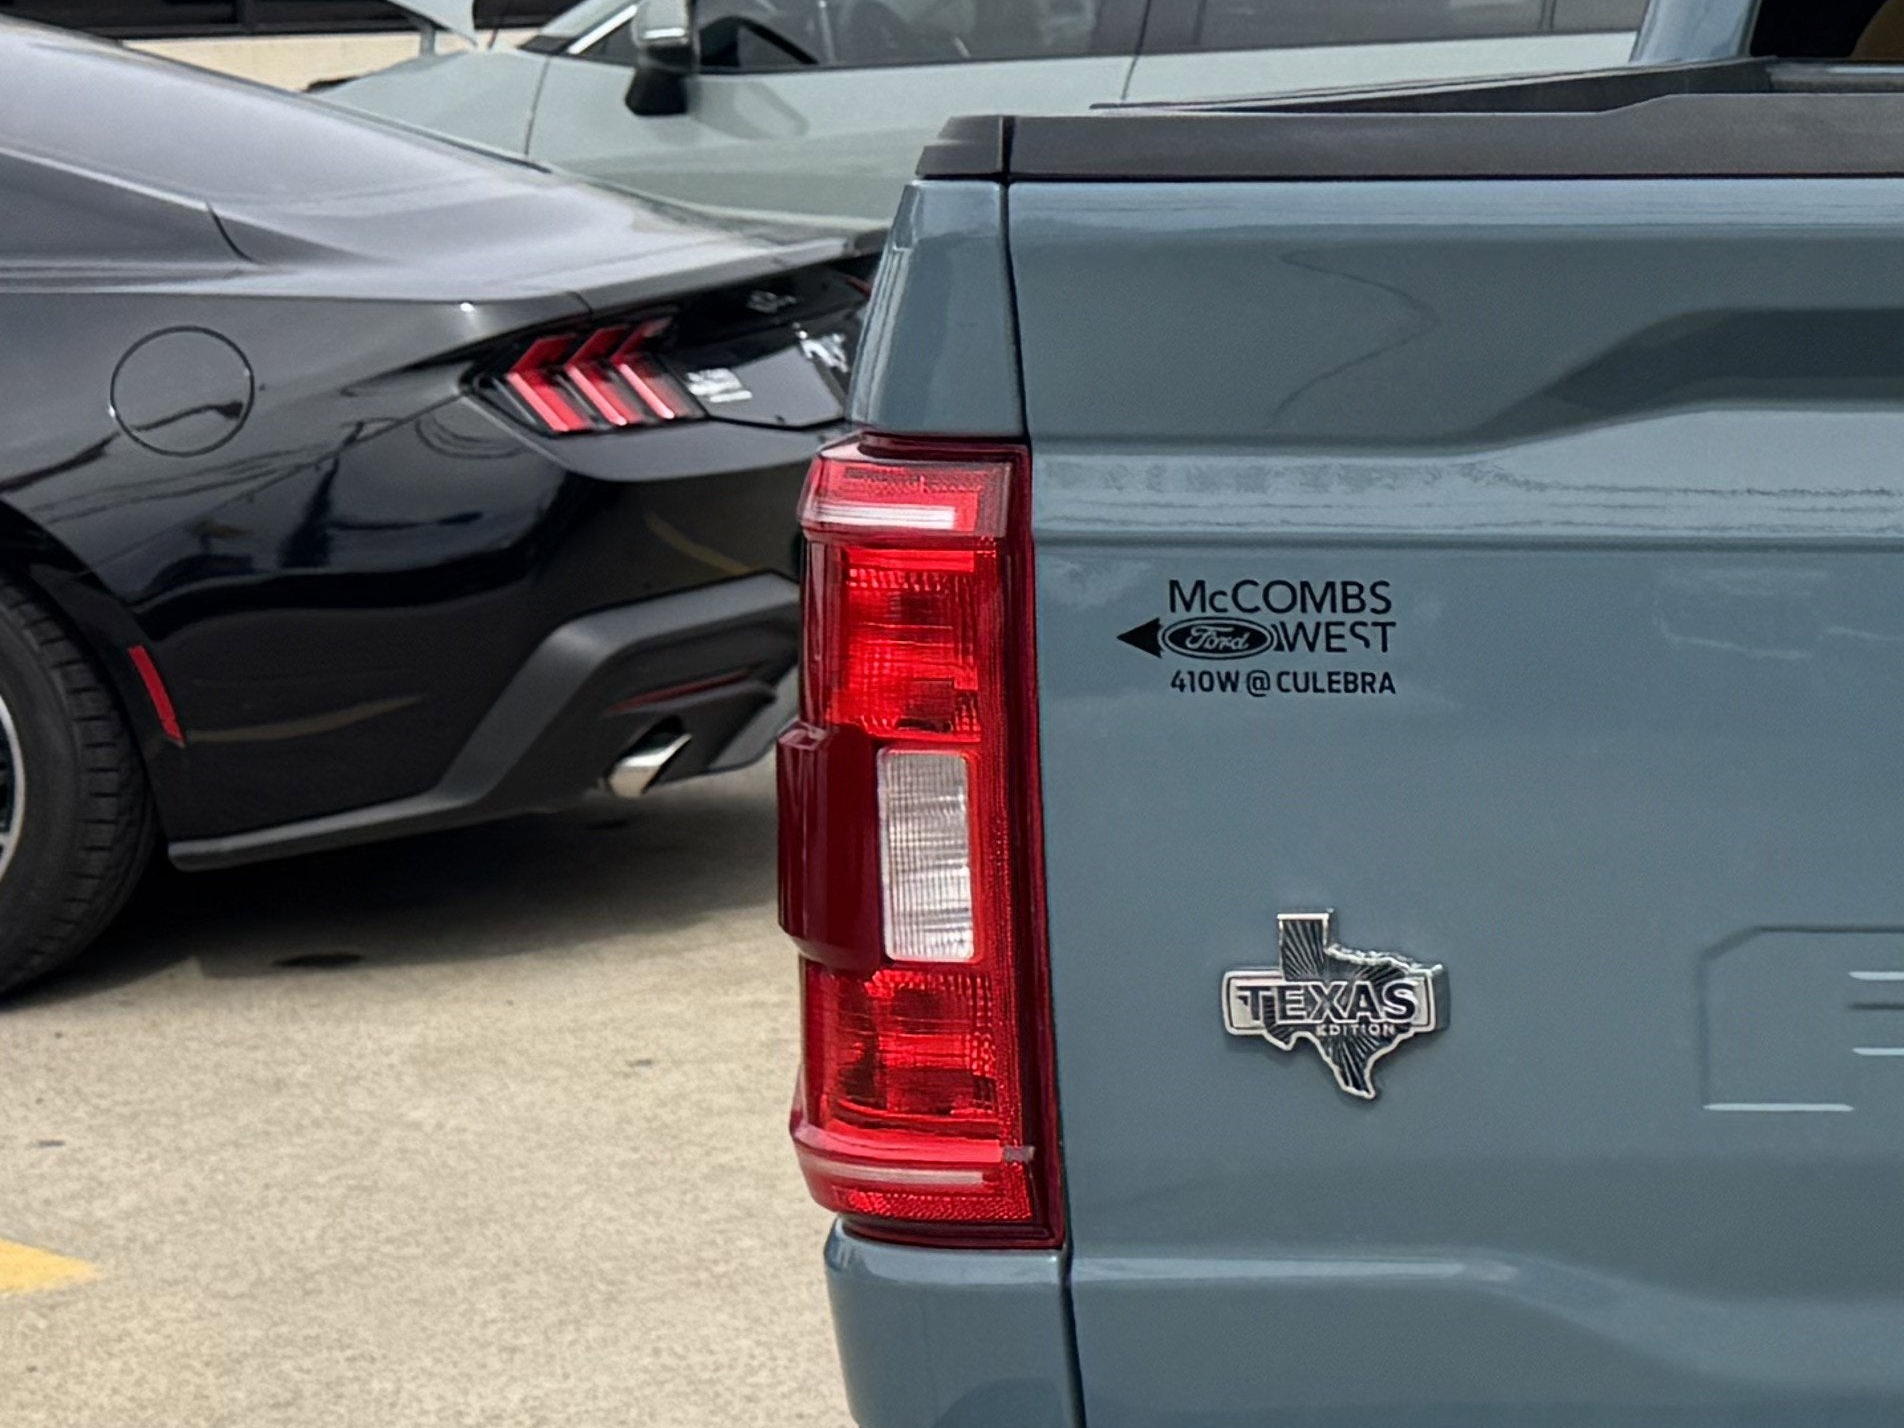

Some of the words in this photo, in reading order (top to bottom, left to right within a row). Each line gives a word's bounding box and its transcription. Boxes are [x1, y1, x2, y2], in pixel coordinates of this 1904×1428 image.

[1168, 579, 1392, 614] McCOMBS
[1185, 623, 1250, 652] Ford
[1278, 621, 1397, 653] WEST
[1276, 670, 1397, 694] CULEBRA
[1235, 978, 1417, 1022] TEXAS
